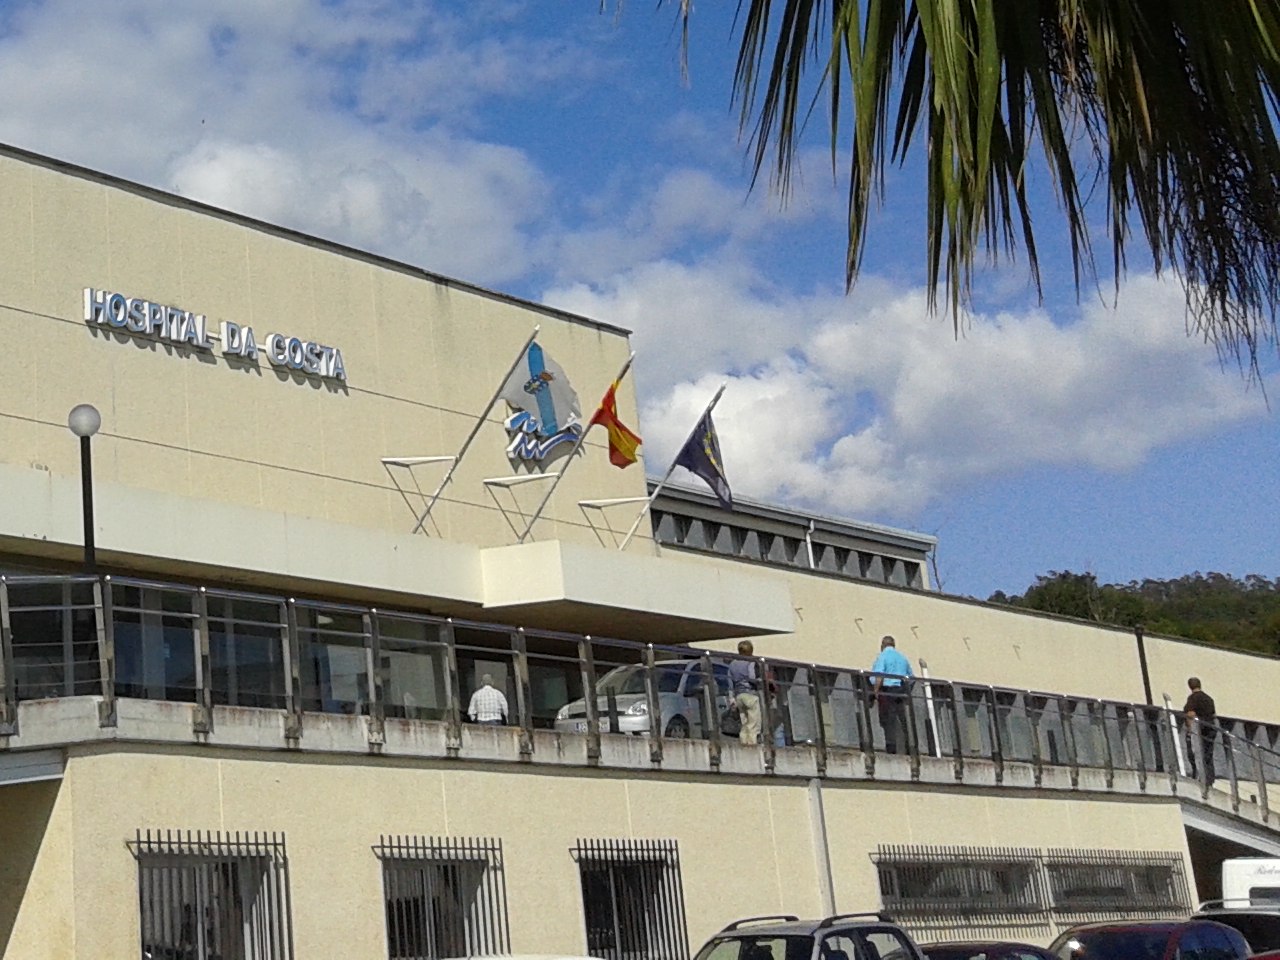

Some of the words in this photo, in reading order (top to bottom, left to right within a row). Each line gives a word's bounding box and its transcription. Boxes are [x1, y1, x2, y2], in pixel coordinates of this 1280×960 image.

[84, 287, 214, 349] HOSPITAL
[220, 321, 259, 360] DA
[265, 333, 347, 380] COSTA
